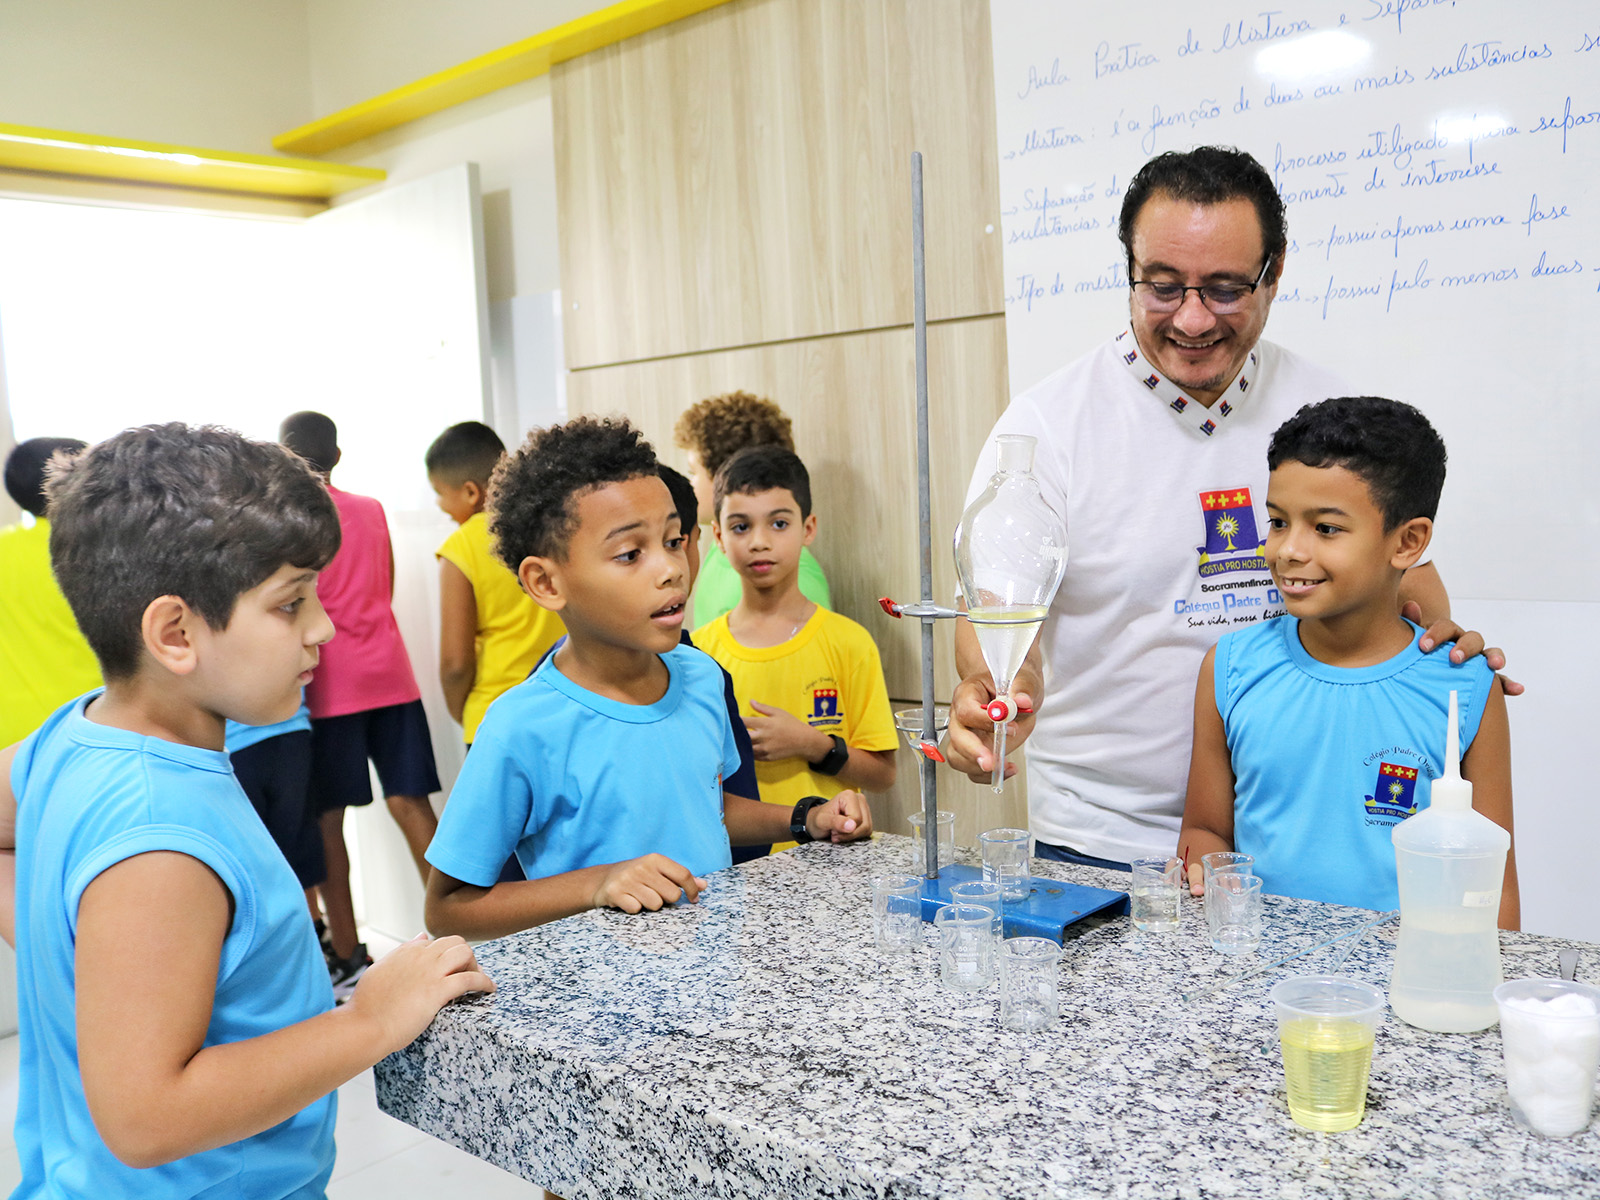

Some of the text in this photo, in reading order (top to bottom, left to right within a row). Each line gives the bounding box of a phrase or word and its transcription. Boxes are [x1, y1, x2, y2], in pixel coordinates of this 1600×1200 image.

[1018, 58, 1070, 100] Aula
[1178, 29, 1202, 57] de
[1338, 14, 1349, 27] e
[1233, 86, 1251, 114] de
[1354, 66, 1415, 92] mais
[1425, 41, 1553, 80] substâncias
[1105, 174, 1122, 197] de
[1365, 167, 1385, 192] de
[1326, 194, 1571, 261] possui apenas uma fase
[1050, 272, 1064, 293] de
[1074, 262, 1128, 293] mistu
[1322, 275, 1382, 320] possui
[1386, 258, 1433, 312] pelo
[1441, 269, 1519, 289] menos
[1531, 251, 1583, 277] duas
[1200, 558, 1269, 575] HOSTIA PRO HOSTIA
[1201, 578, 1274, 593] Sacramentinas
[1174, 598, 1220, 614] Colégio
[1222, 592, 1262, 613] Padre
[1188, 617, 1205, 628] Sua
[1233, 615, 1258, 624] nossa
